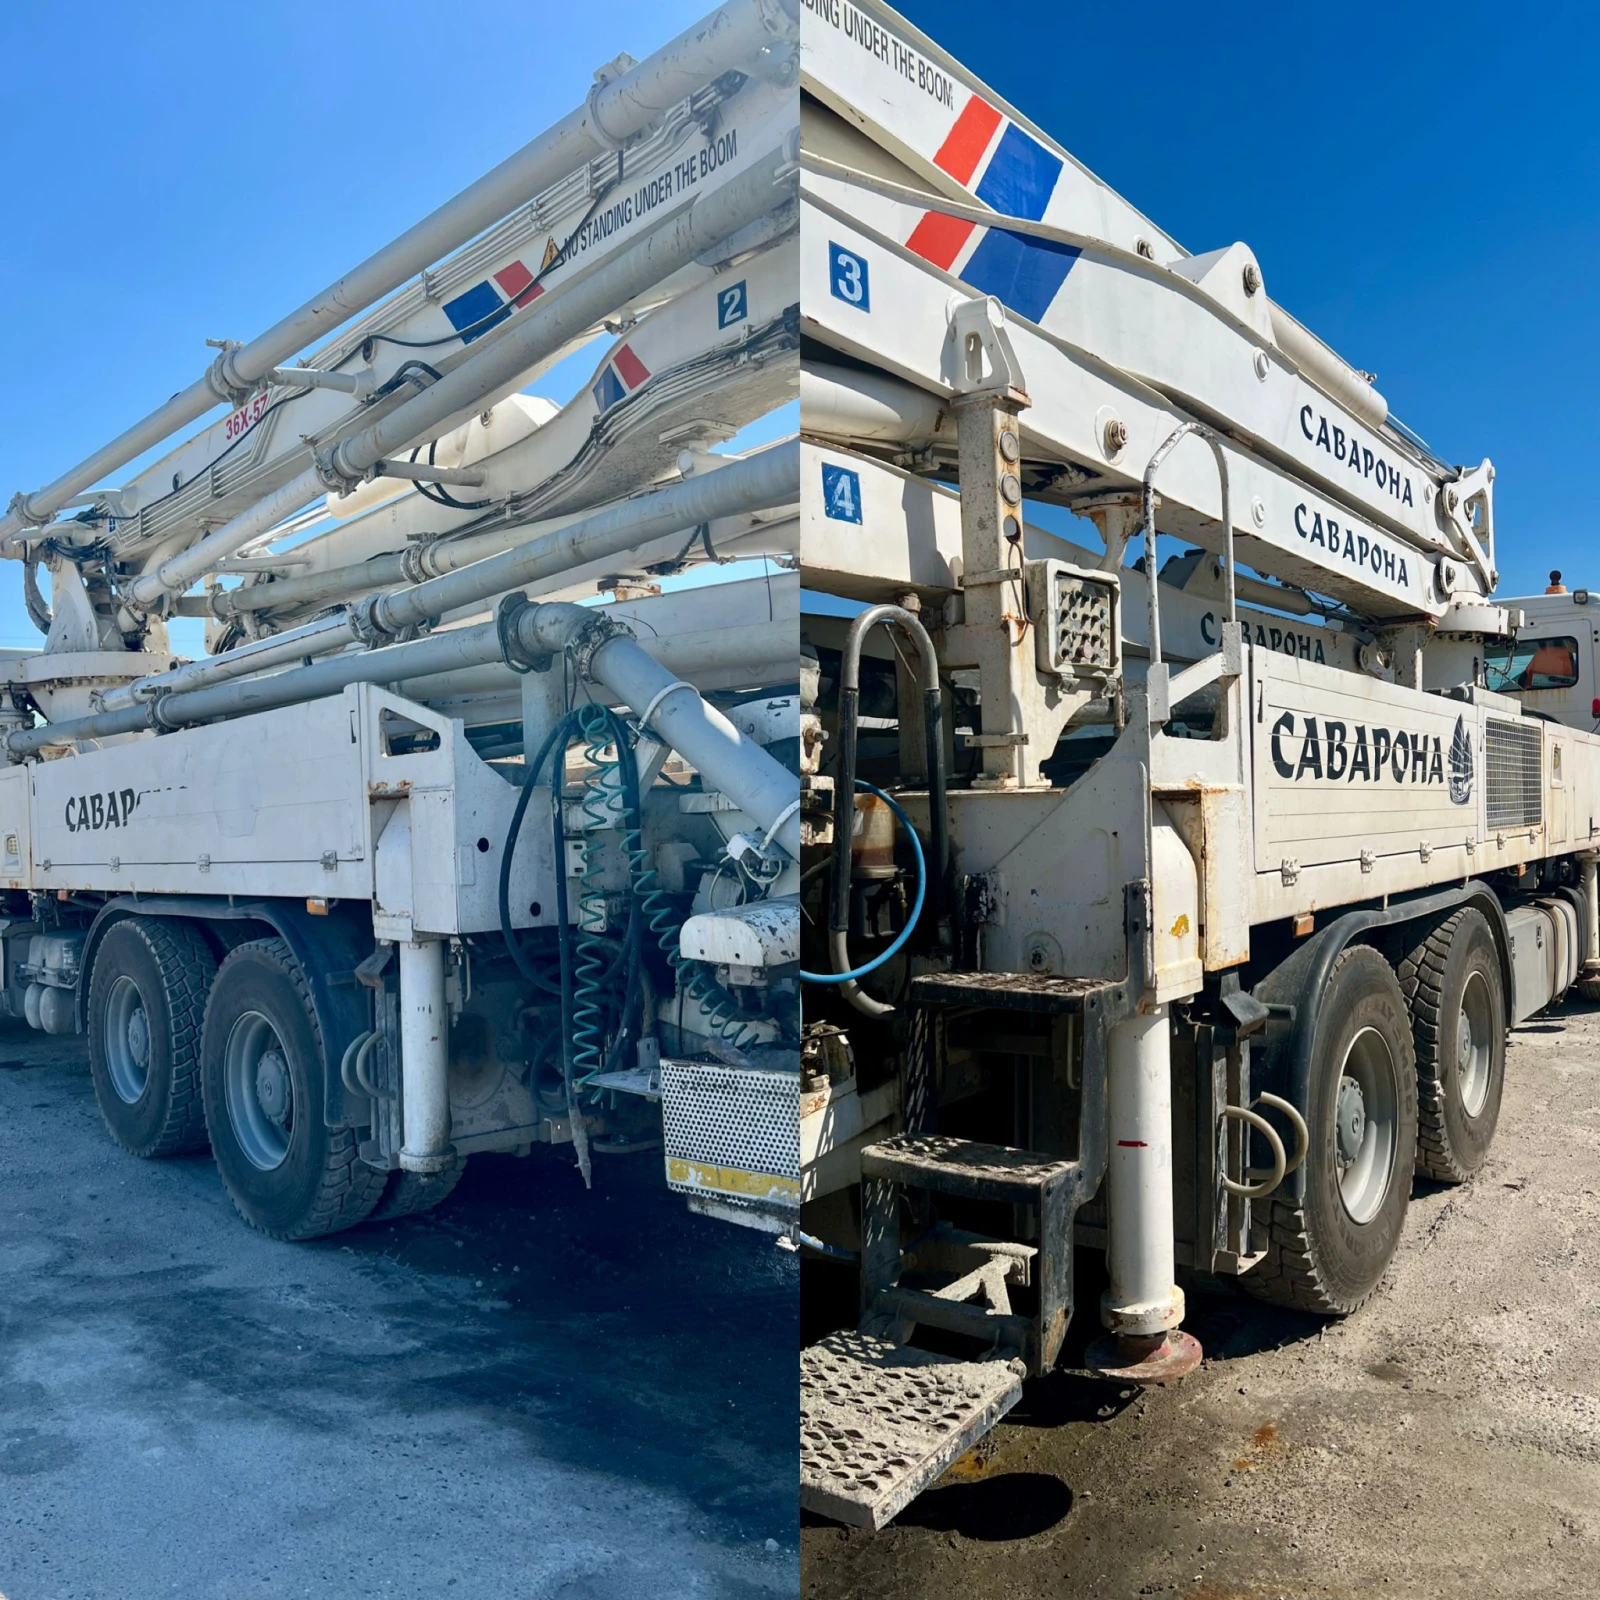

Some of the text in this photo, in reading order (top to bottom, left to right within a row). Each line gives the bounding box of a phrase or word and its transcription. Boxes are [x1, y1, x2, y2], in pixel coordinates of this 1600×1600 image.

[800, 0, 954, 111] ING UNDER THE BOOM
[580, 197, 632, 251] STANDING
[635, 172, 672, 217] UNDER
[675, 155, 697, 193] THE
[700, 129, 737, 178] BOOM
[723, 288, 742, 324] 2
[837, 253, 863, 302] 3
[1300, 404, 1413, 507] САВАРОНА
[833, 474, 855, 517] 4
[1294, 503, 1408, 587] САВАРОНА
[1201, 612, 1326, 665] СВАРОНА
[1271, 710, 1444, 786] САВАРОНА
[65, 786, 188, 832] САВАР
